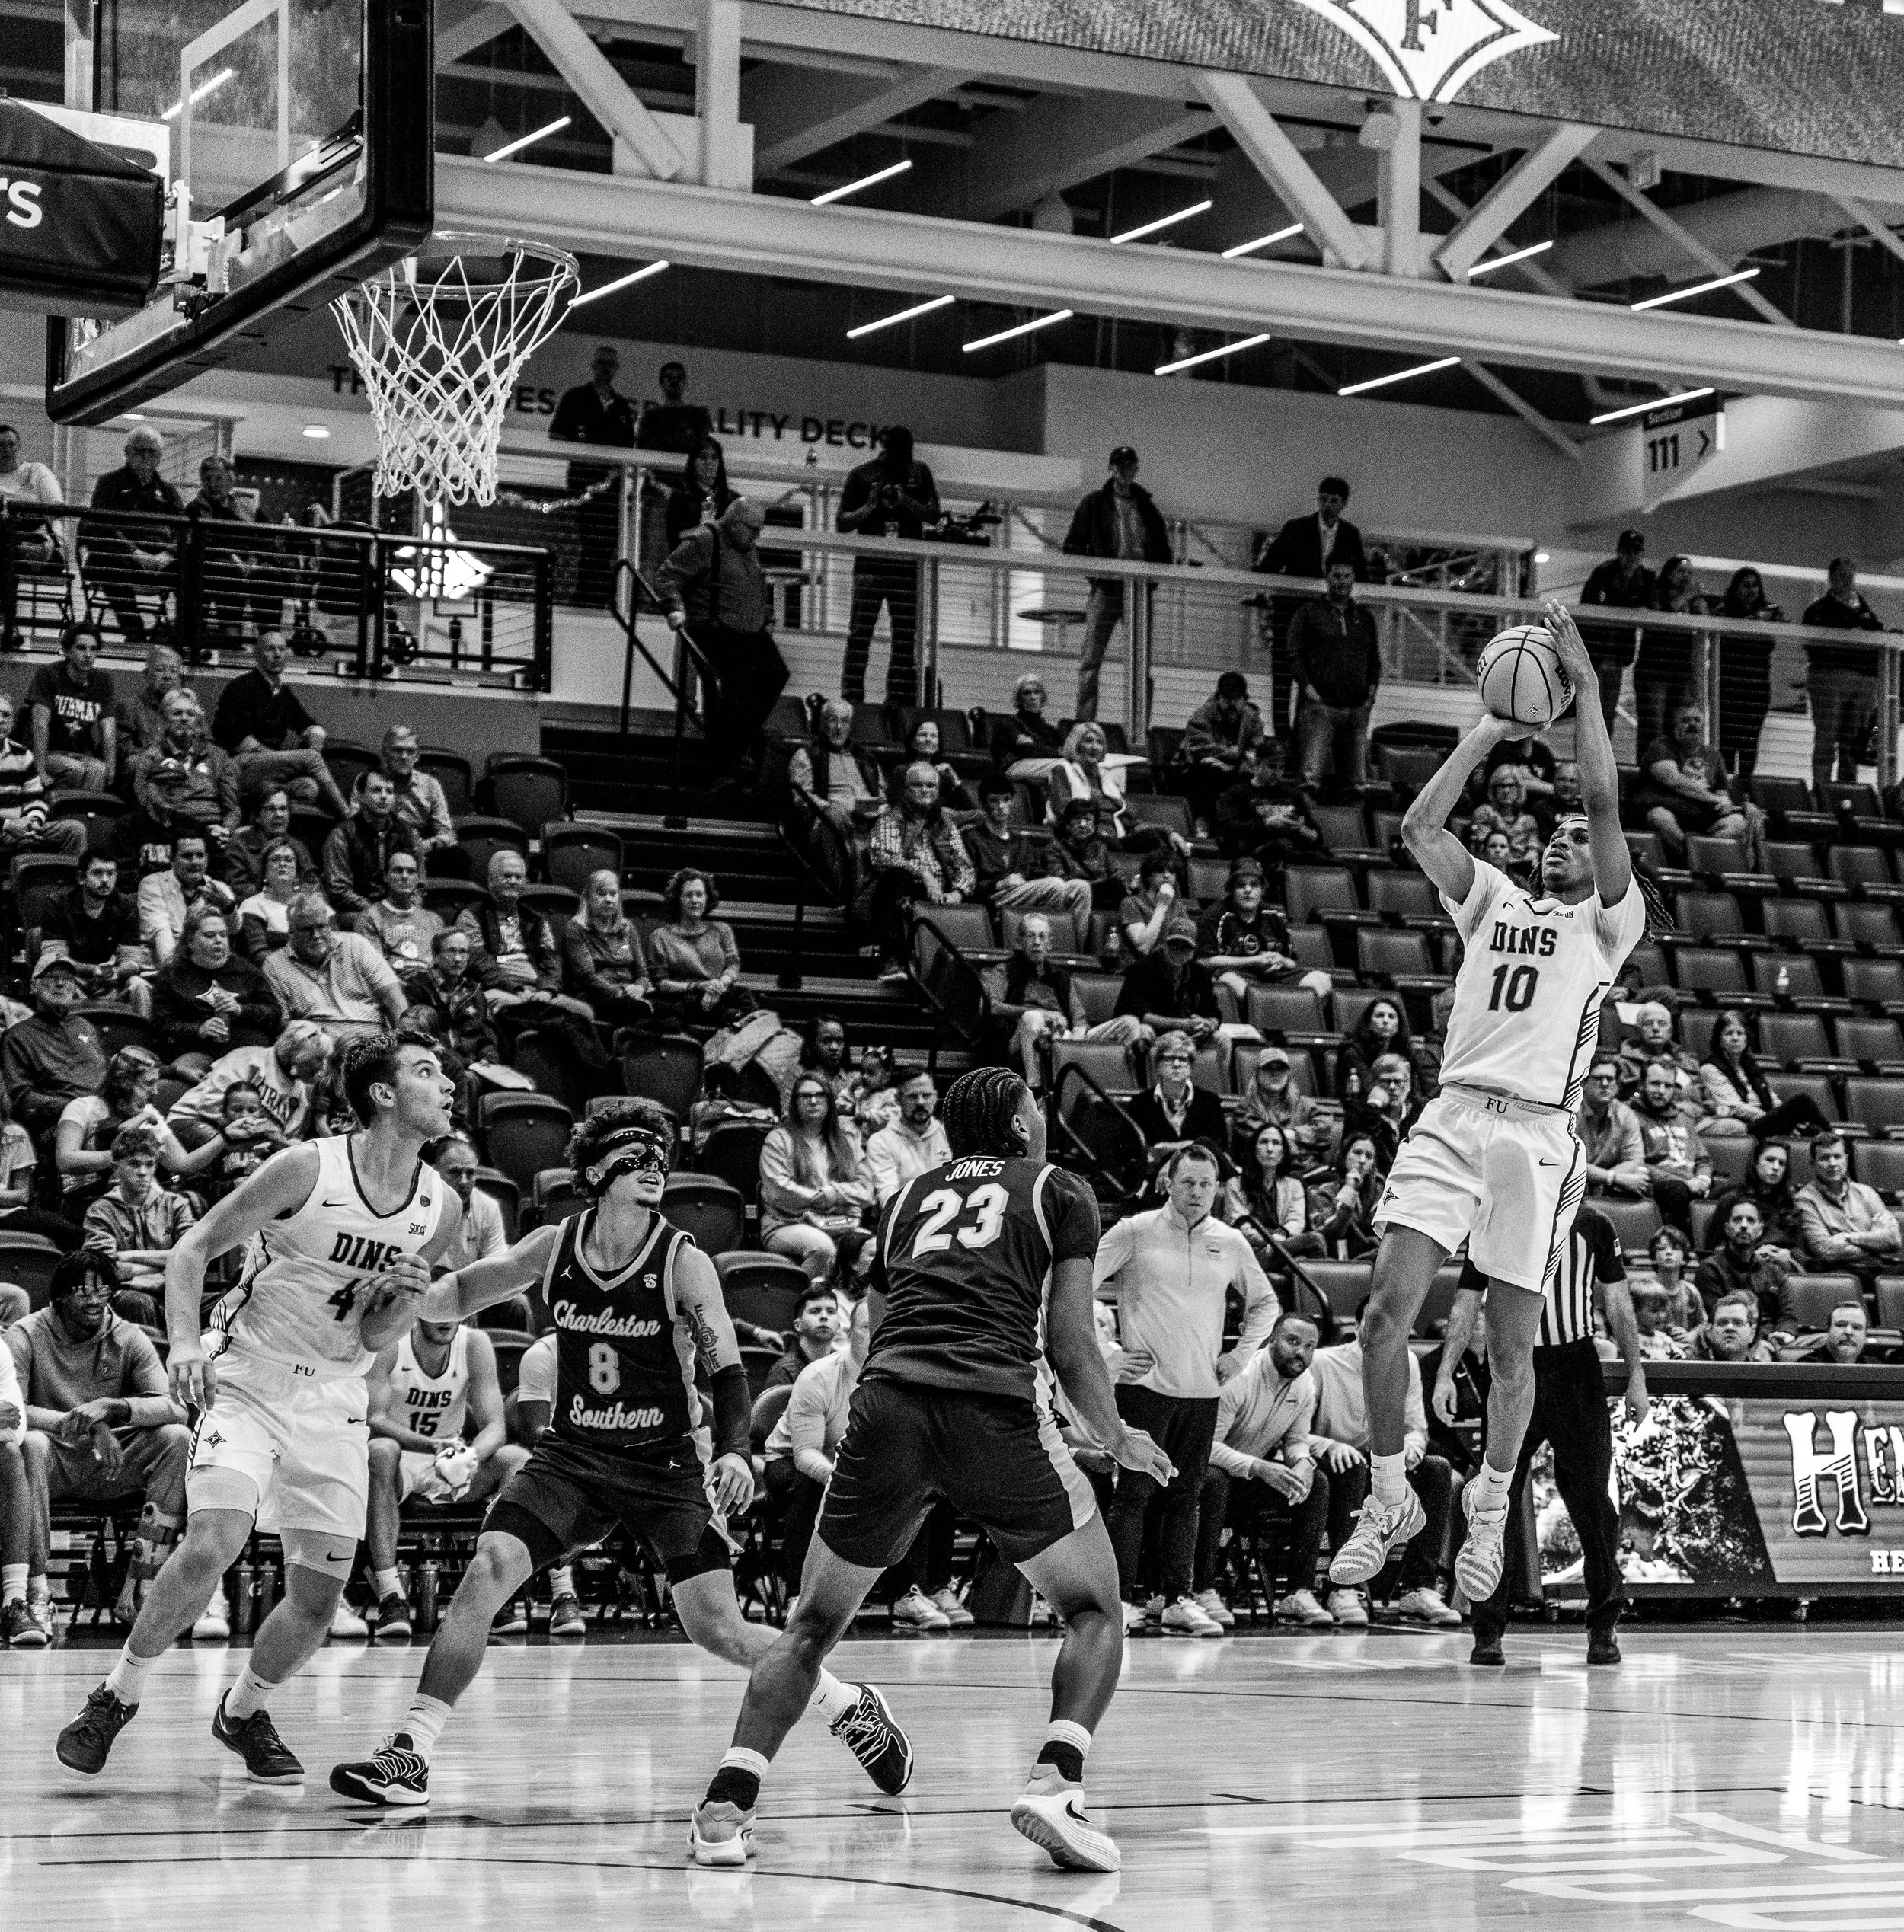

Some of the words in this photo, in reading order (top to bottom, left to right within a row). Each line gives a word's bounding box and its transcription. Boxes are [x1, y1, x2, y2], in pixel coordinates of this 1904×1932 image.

[1400, 0, 1452, 51] F
[0, 177, 43, 228] S
[1648, 433, 1679, 471] 111
[1489, 921, 1558, 956] DINS
[1487, 963, 1540, 1013] 10
[1485, 1097, 1509, 1113] FU
[945, 1160, 1005, 1182] JONES
[912, 1183, 1009, 1259] 23
[328, 1231, 403, 1273] DINS
[327, 1278, 362, 1322] 4
[554, 1299, 661, 1337] Charleston
[589, 1342, 620, 1394] 8
[405, 1387, 452, 1408] DINS
[570, 1394, 664, 1429] Southern
[408, 1411, 441, 1437] 15
